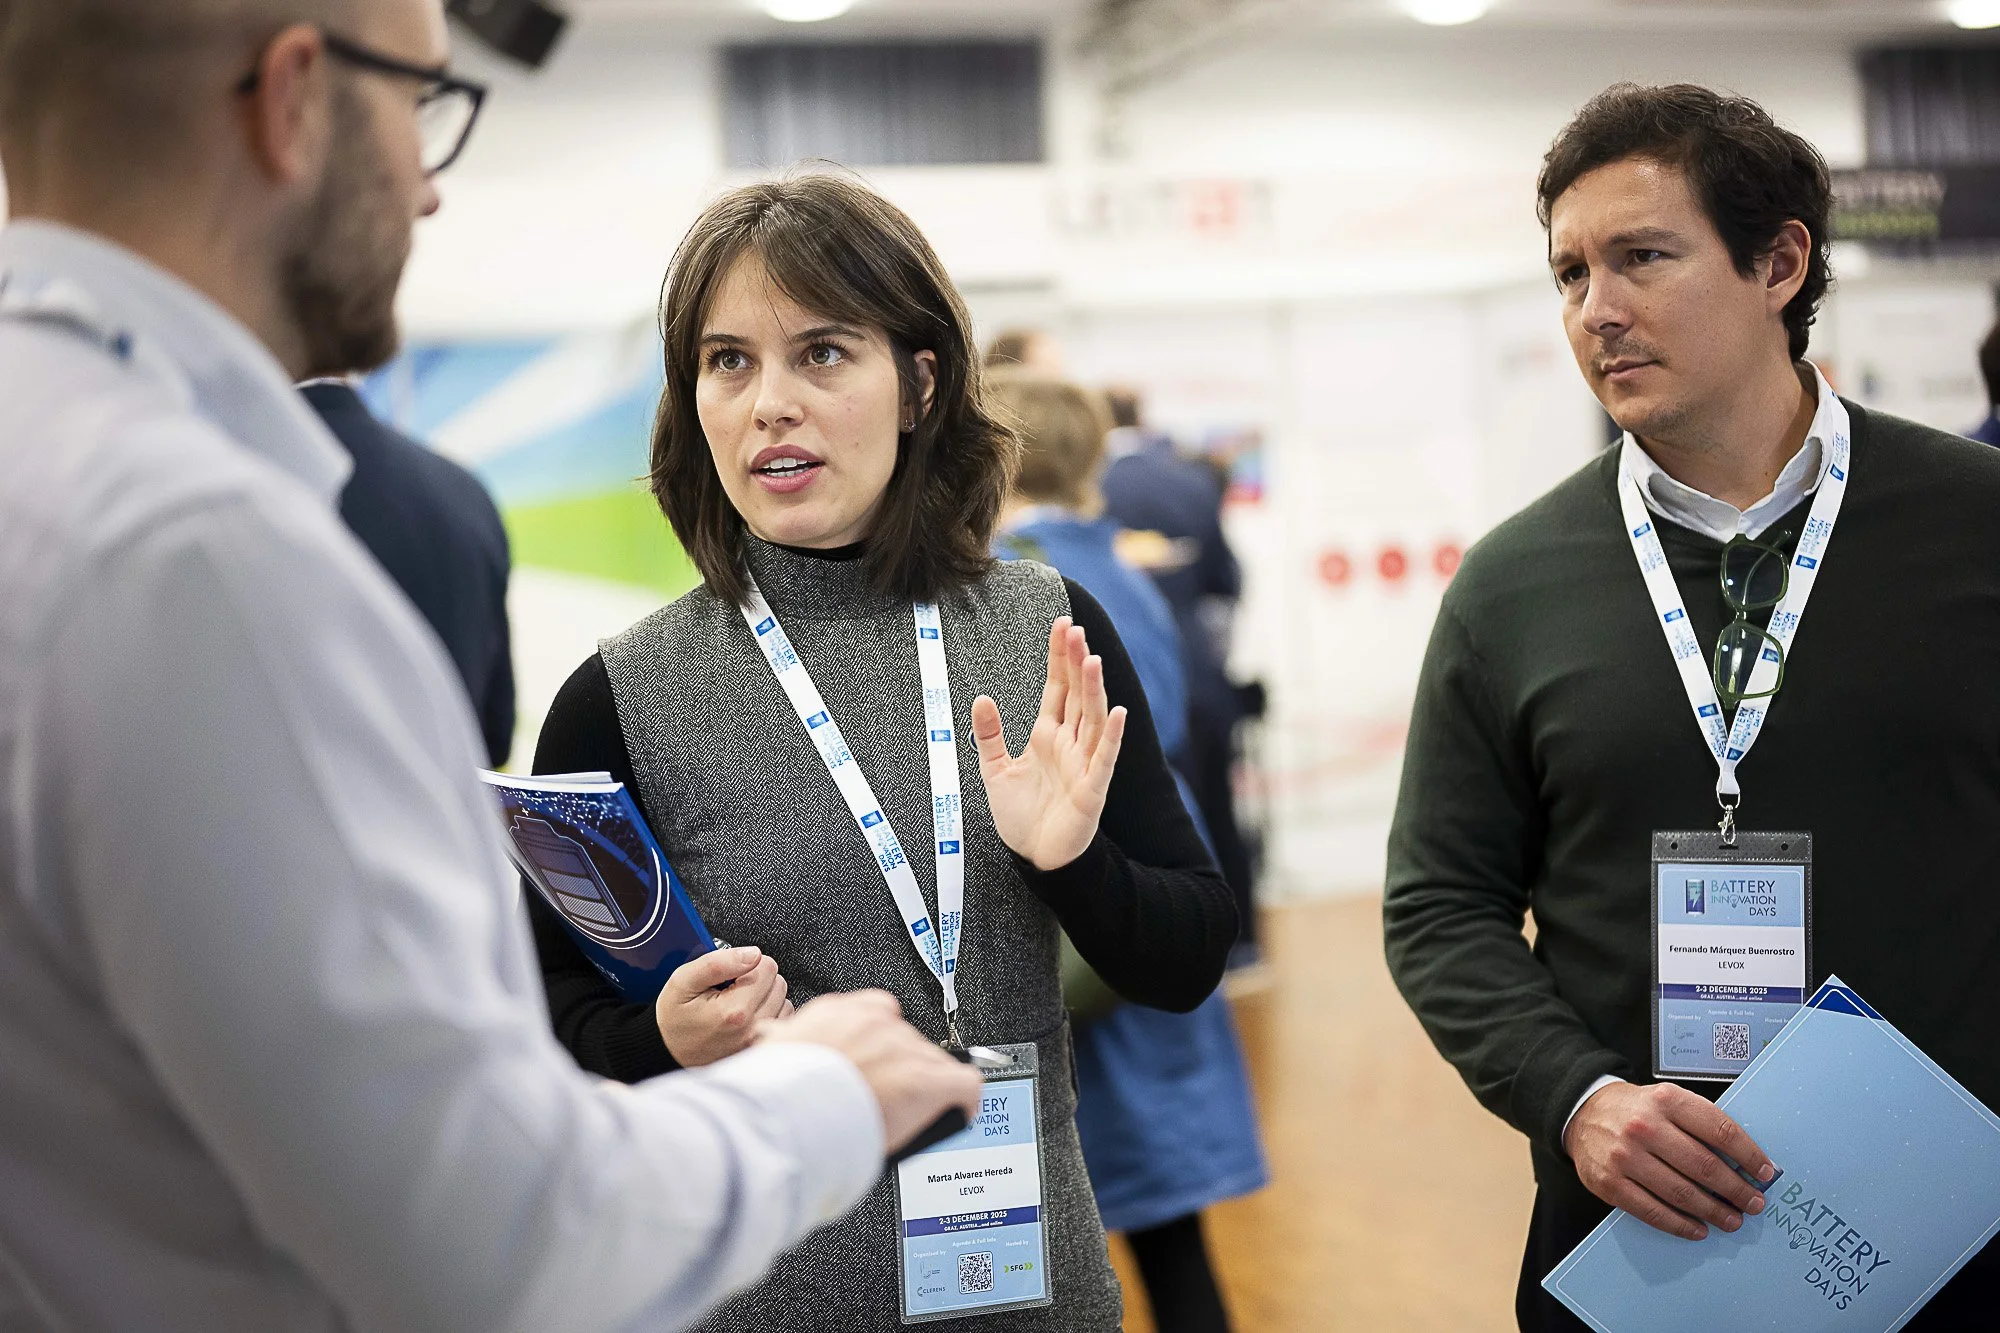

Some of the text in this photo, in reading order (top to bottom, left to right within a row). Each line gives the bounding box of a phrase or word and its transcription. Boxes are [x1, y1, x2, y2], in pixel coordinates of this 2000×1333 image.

[773, 629, 798, 666] BATTERY
[771, 657, 784, 674] DAYS
[1731, 706, 1749, 745] BATTERY
[935, 795, 945, 838] BATTERY
[880, 824, 906, 865] BATTERY
[878, 854, 891, 873] DAYS
[1711, 879, 1775, 894] BATTERY
[1749, 907, 1777, 917] DAYS
[941, 912, 951, 957] BATTERY
[1669, 945, 1795, 956] Fernando Márquez Buenrostro
[1718, 961, 1745, 970] LEVOX
[1695, 985, 1768, 995] 2-3 DECEMBER 2025
[984, 1125, 1010, 1137] DAYS
[927, 1166, 1013, 1184] Marta Alvarez Hereda
[959, 1185, 985, 1196] LEVOX
[939, 1210, 1008, 1225] 2-3 DECEMBER 2025
[1779, 1181, 1891, 1275] BATTERY
[1010, 1264, 1024, 1272] SFG
[1803, 1267, 1852, 1311] DAYS
